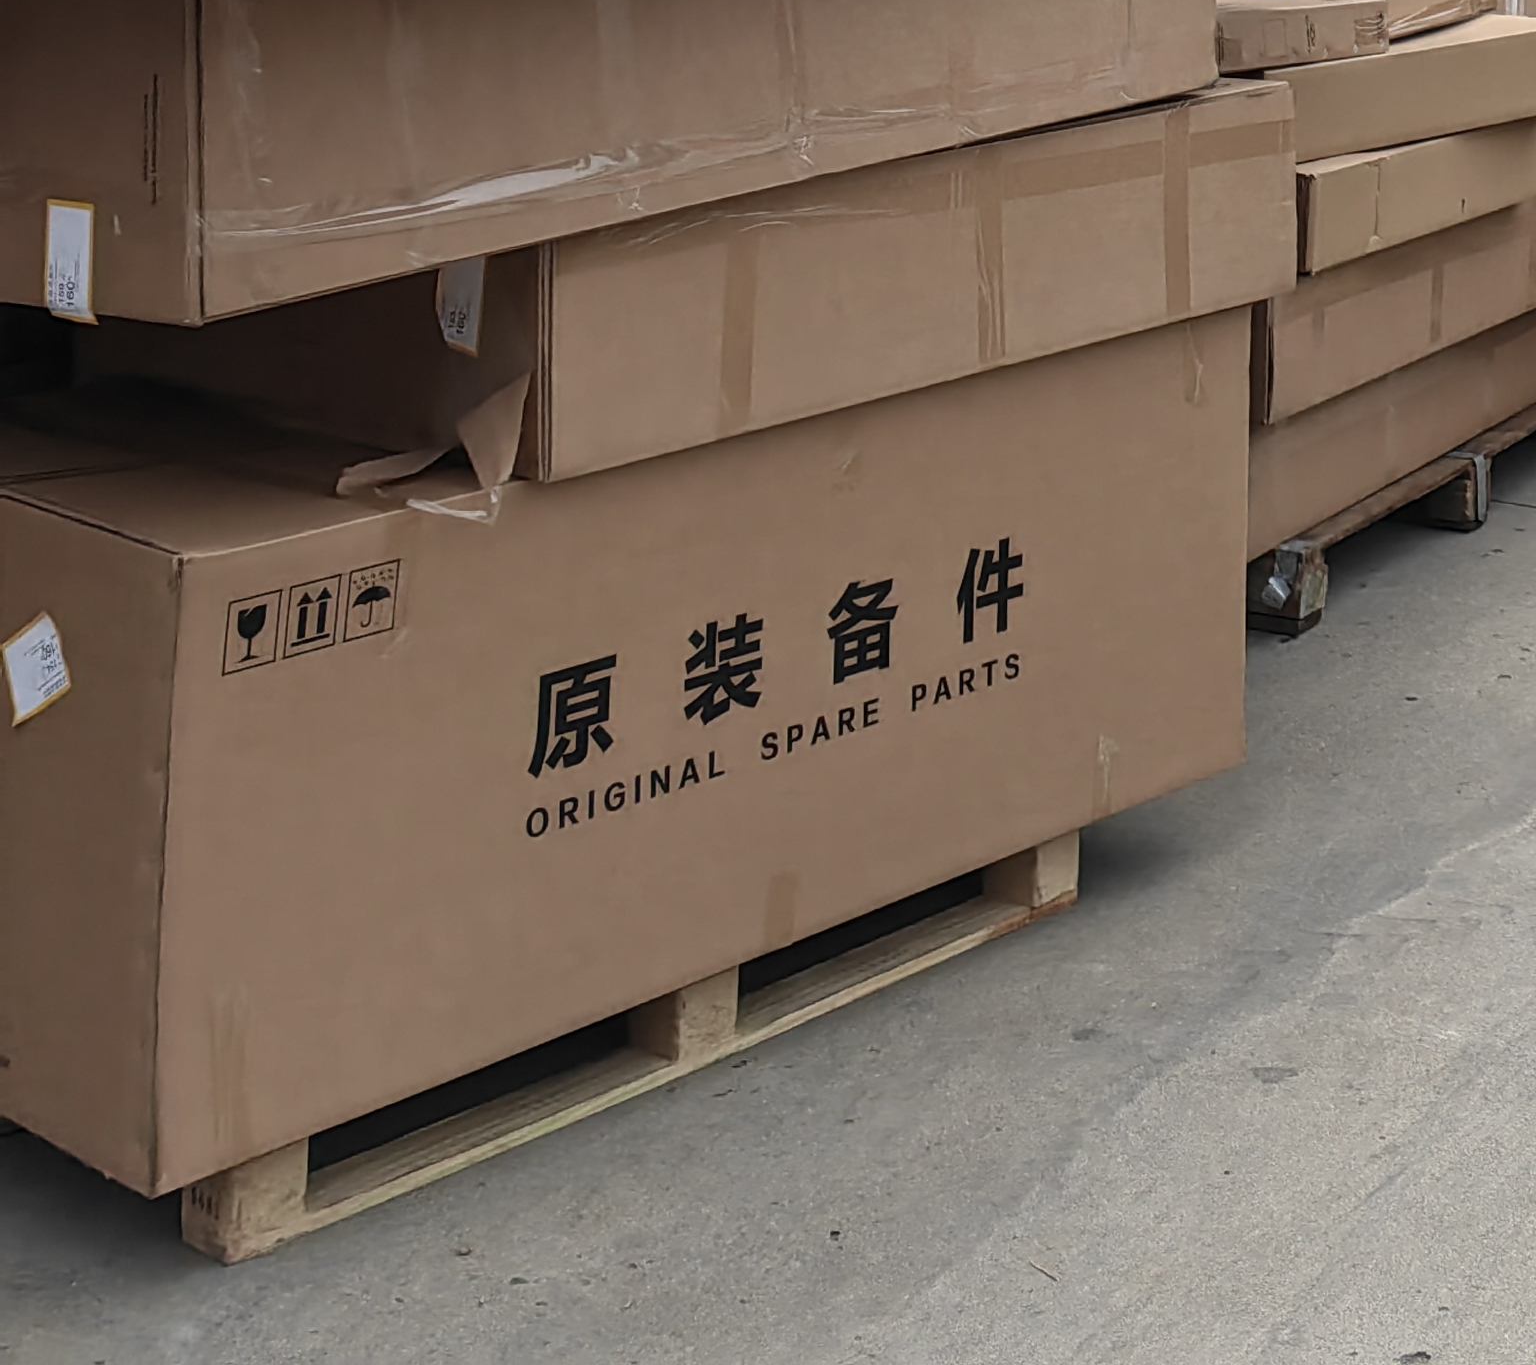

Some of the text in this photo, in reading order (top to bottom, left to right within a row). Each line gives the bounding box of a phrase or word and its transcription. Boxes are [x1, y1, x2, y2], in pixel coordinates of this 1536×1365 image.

[525, 653, 1021, 838] ORIGINAL SPARE PARTS
[528, 538, 1024, 778] 原装备件
